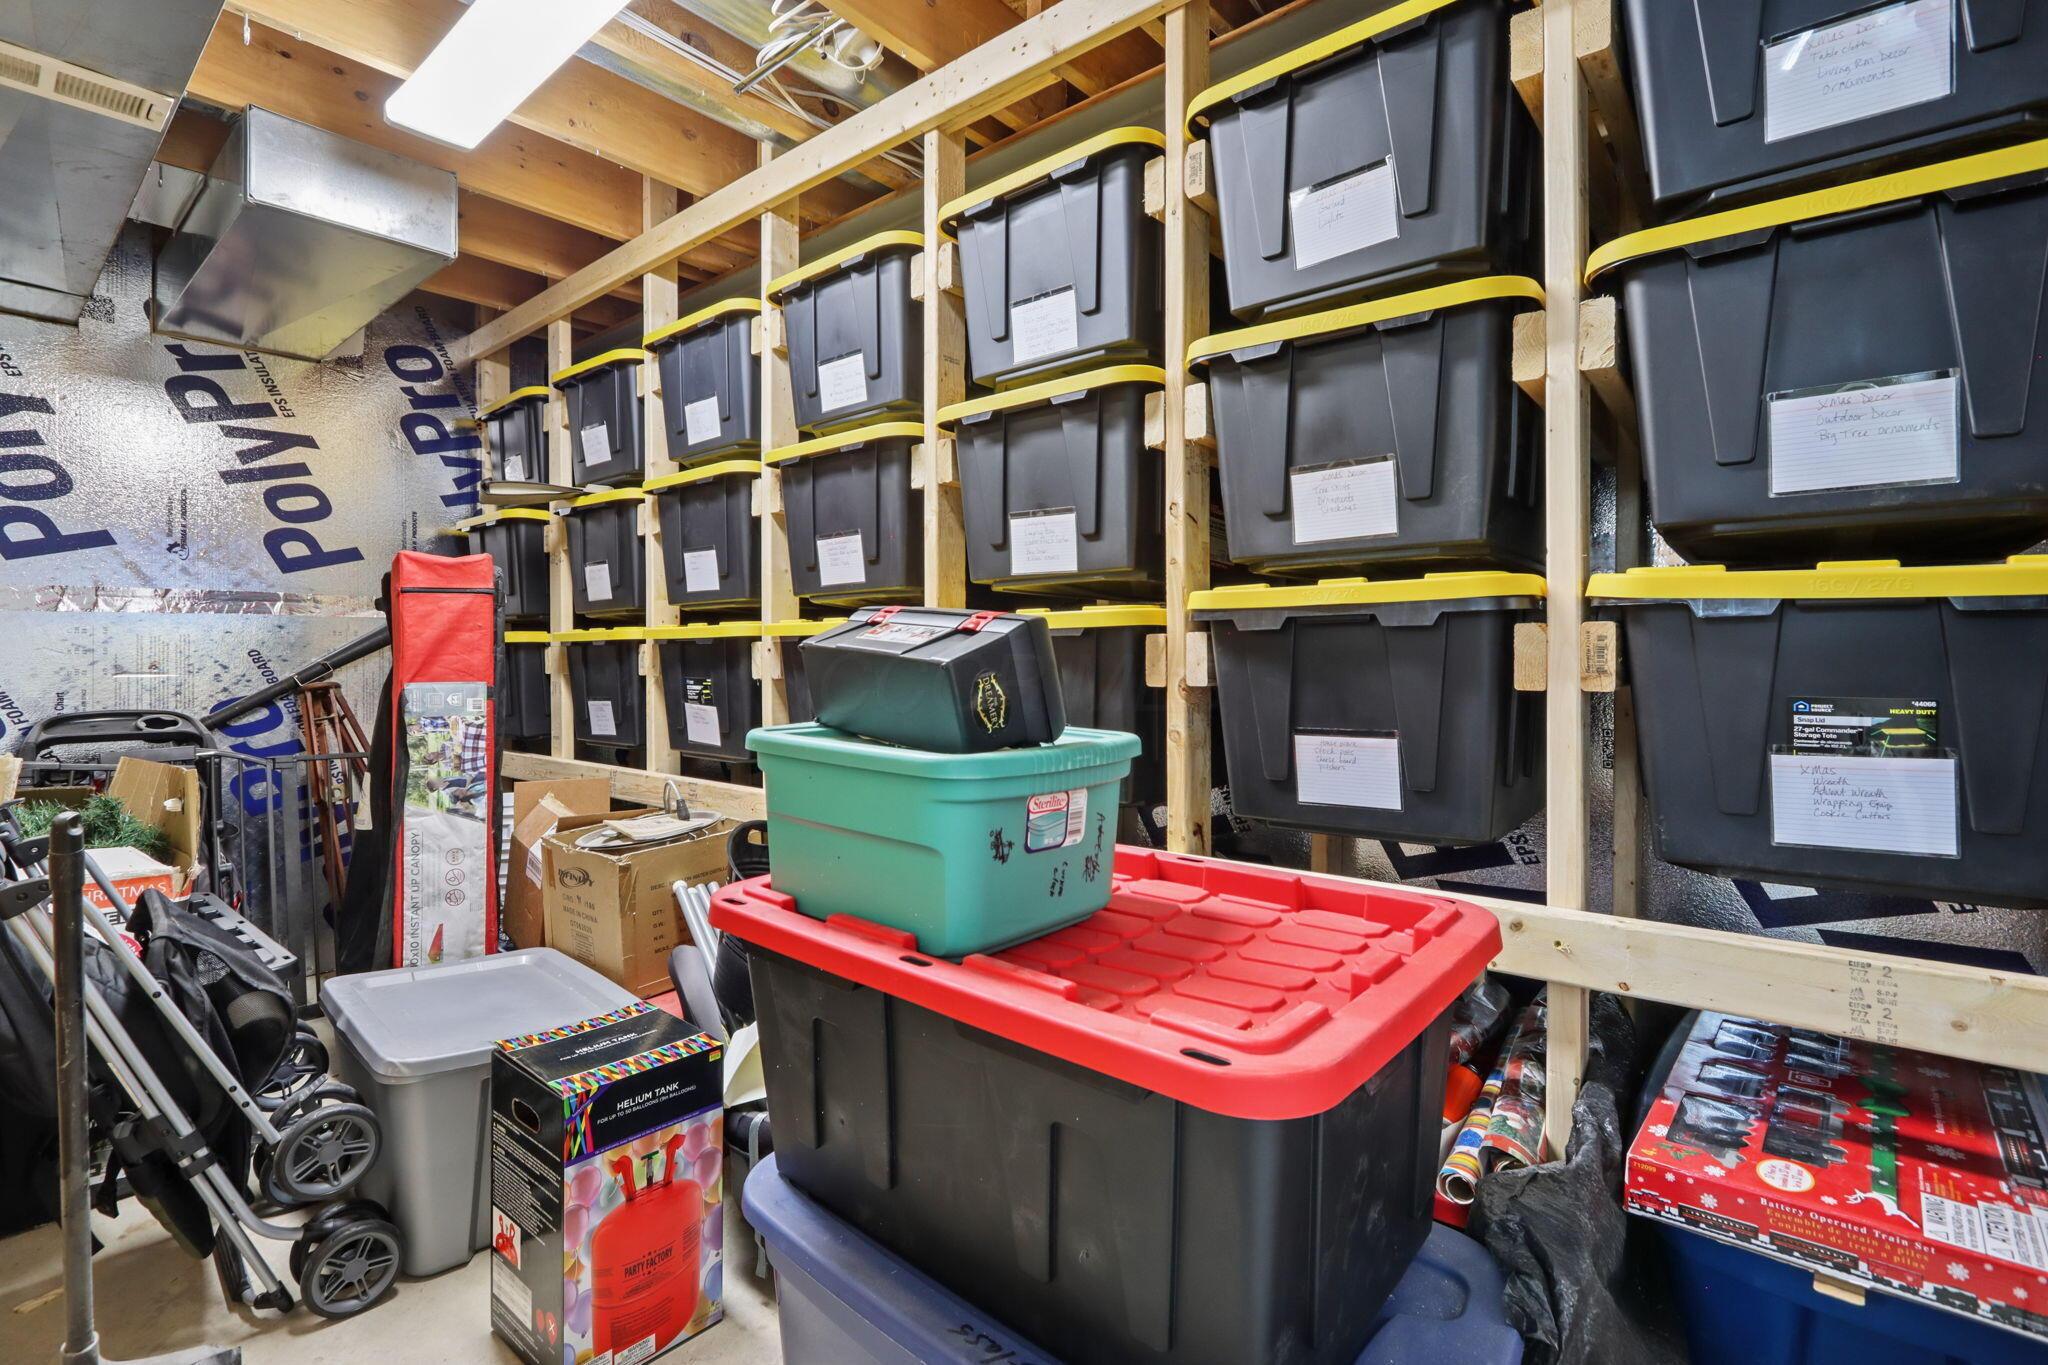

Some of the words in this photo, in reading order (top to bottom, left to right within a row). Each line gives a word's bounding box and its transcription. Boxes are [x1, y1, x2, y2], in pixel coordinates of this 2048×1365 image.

[269, 398, 296, 418] EPS
[247, 649, 279, 684] BOARD
[982, 676, 1001, 730] DREAMERY
[1033, 795, 1063, 810] Sterilite
[409, 832, 421, 877] CANOPY
[1509, 833, 1541, 865] EPS
[409, 878, 421, 892] UP
[409, 894, 421, 940] INSTANT
[1882, 966, 1892, 979] 2
[1882, 1007, 1893, 1020] 2
[597, 1117, 608, 1125] FOR
[632, 1098, 659, 1112] BALLOONS
[616, 1091, 653, 1111] HELIUM
[654, 1081, 680, 1097] TANK
[1760, 1197, 1804, 1217] Battery
[1810, 1211, 1867, 1235] Operated
[1873, 1229, 1909, 1246] Train
[1914, 1242, 1937, 1255] Set
[1766, 1207, 1822, 1229] Ensemble
[1827, 1225, 1841, 1235] de
[1847, 1231, 1879, 1246] train
[1896, 1245, 1930, 1261] piles
[1769, 1217, 1824, 1239] Conjunto
[1829, 1234, 1844, 1245] de
[1849, 1241, 1875, 1254] tren
[1893, 1254, 1926, 1270] pilas
[624, 1261, 645, 1278] PARTY
[646, 1247, 673, 1269] FACTORY
